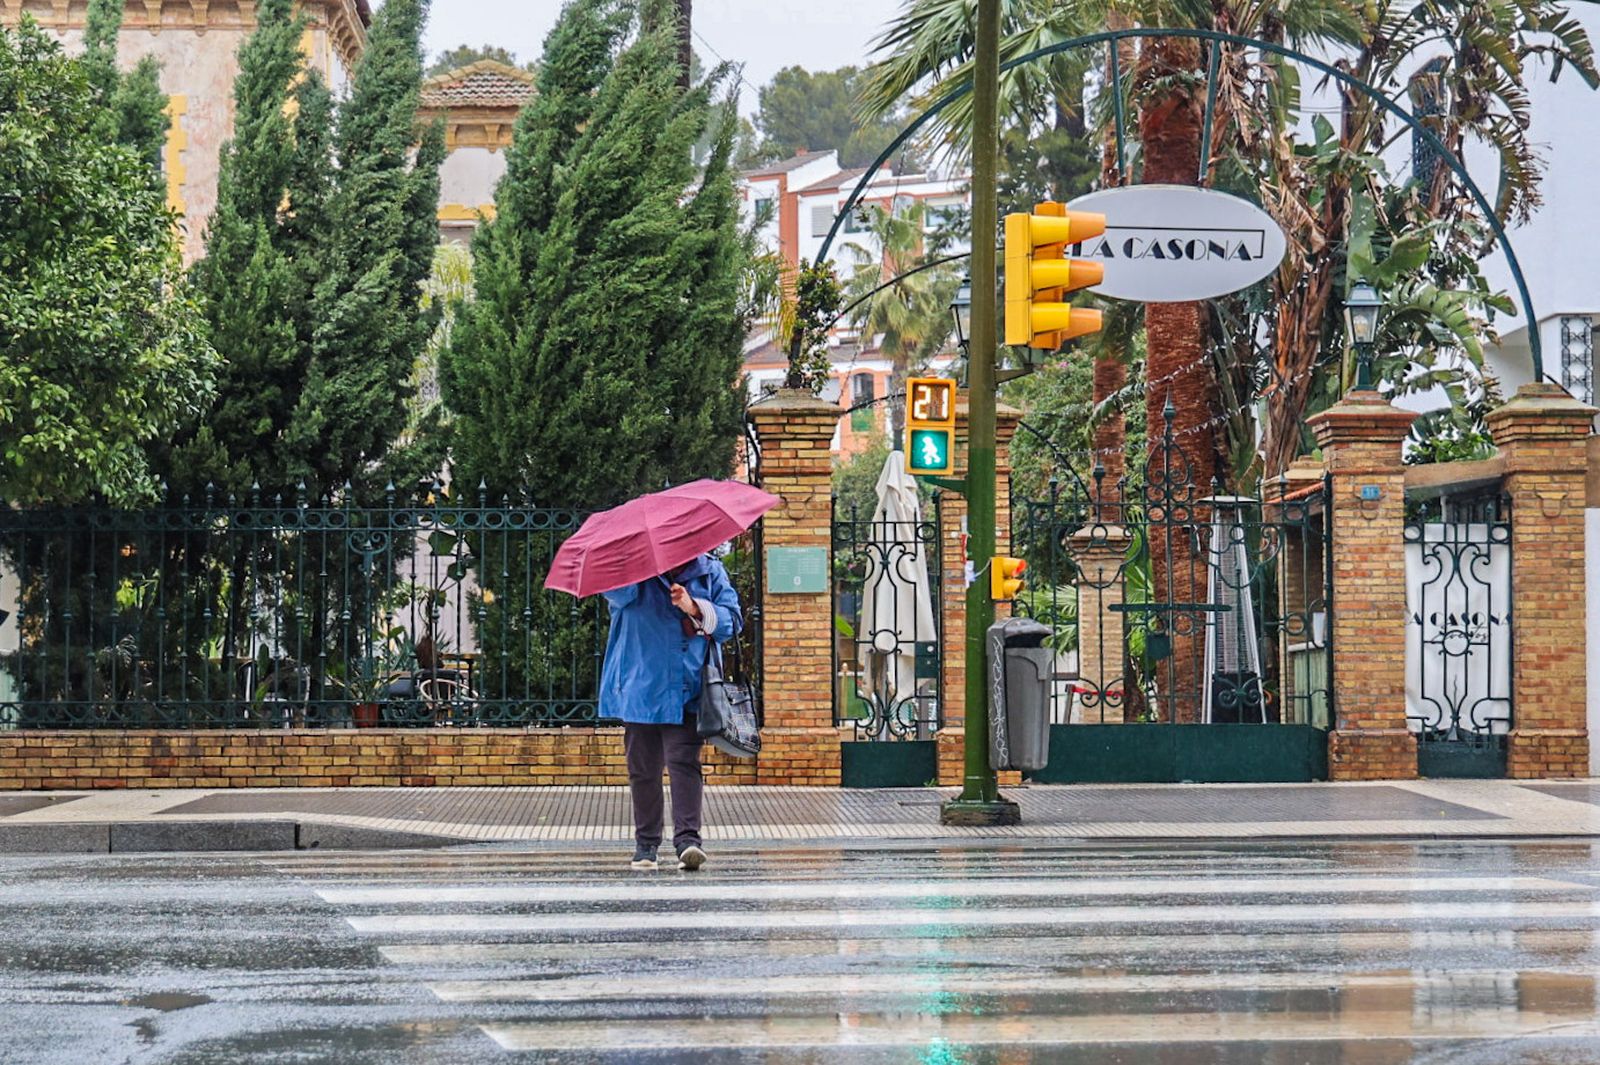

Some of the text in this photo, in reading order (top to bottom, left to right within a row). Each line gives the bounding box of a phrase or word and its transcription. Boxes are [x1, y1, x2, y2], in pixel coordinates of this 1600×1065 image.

[1071, 235, 1252, 261] LA CASONA
[914, 385, 949, 419] 21
